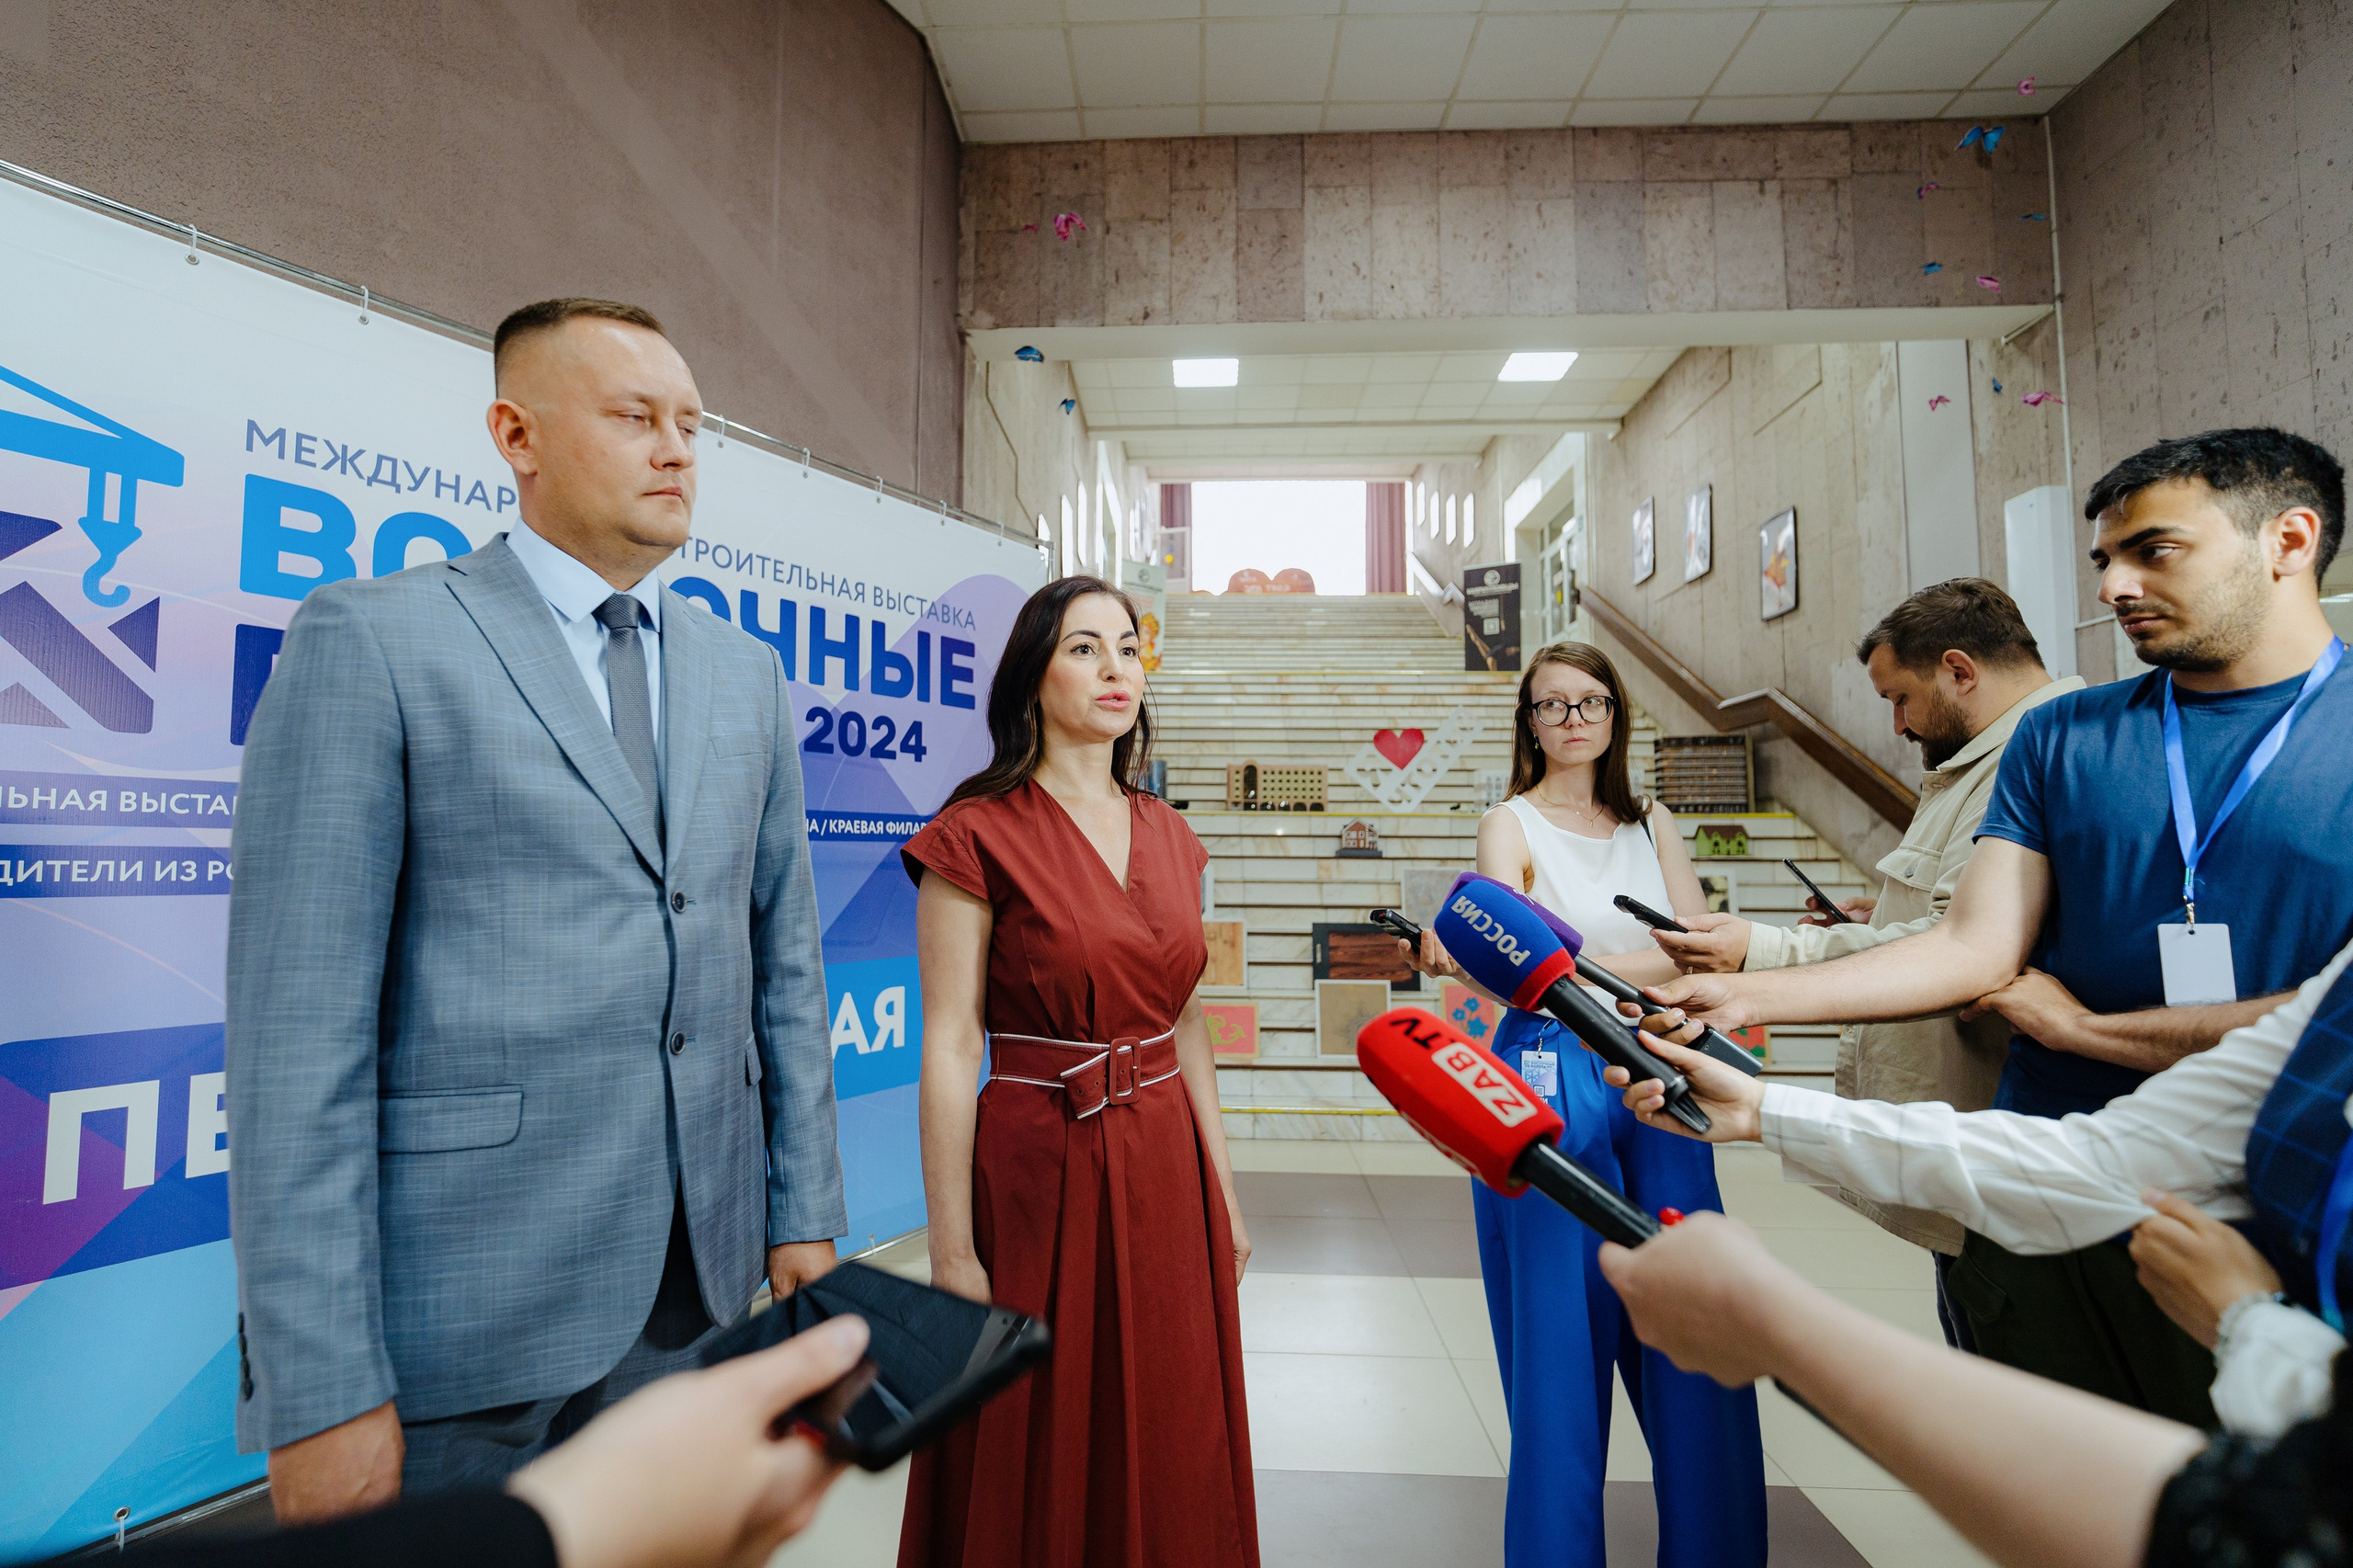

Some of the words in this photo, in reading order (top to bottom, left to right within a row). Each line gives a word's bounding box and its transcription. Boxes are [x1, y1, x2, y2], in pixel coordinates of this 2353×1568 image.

[245, 419, 517, 513] МЕЖДУНАР
[873, 585, 976, 631] ВЫСТАВКА
[803, 706, 927, 763] 2024
[0, 786, 108, 812] ЬНАЯ
[119, 790, 238, 816] ВЫСТА
[806, 818, 819, 834] А
[829, 819, 884, 835] КРАЕВАЯ
[154, 860, 198, 881] ИЗ
[1450, 895, 1531, 967] РОССИЯ
